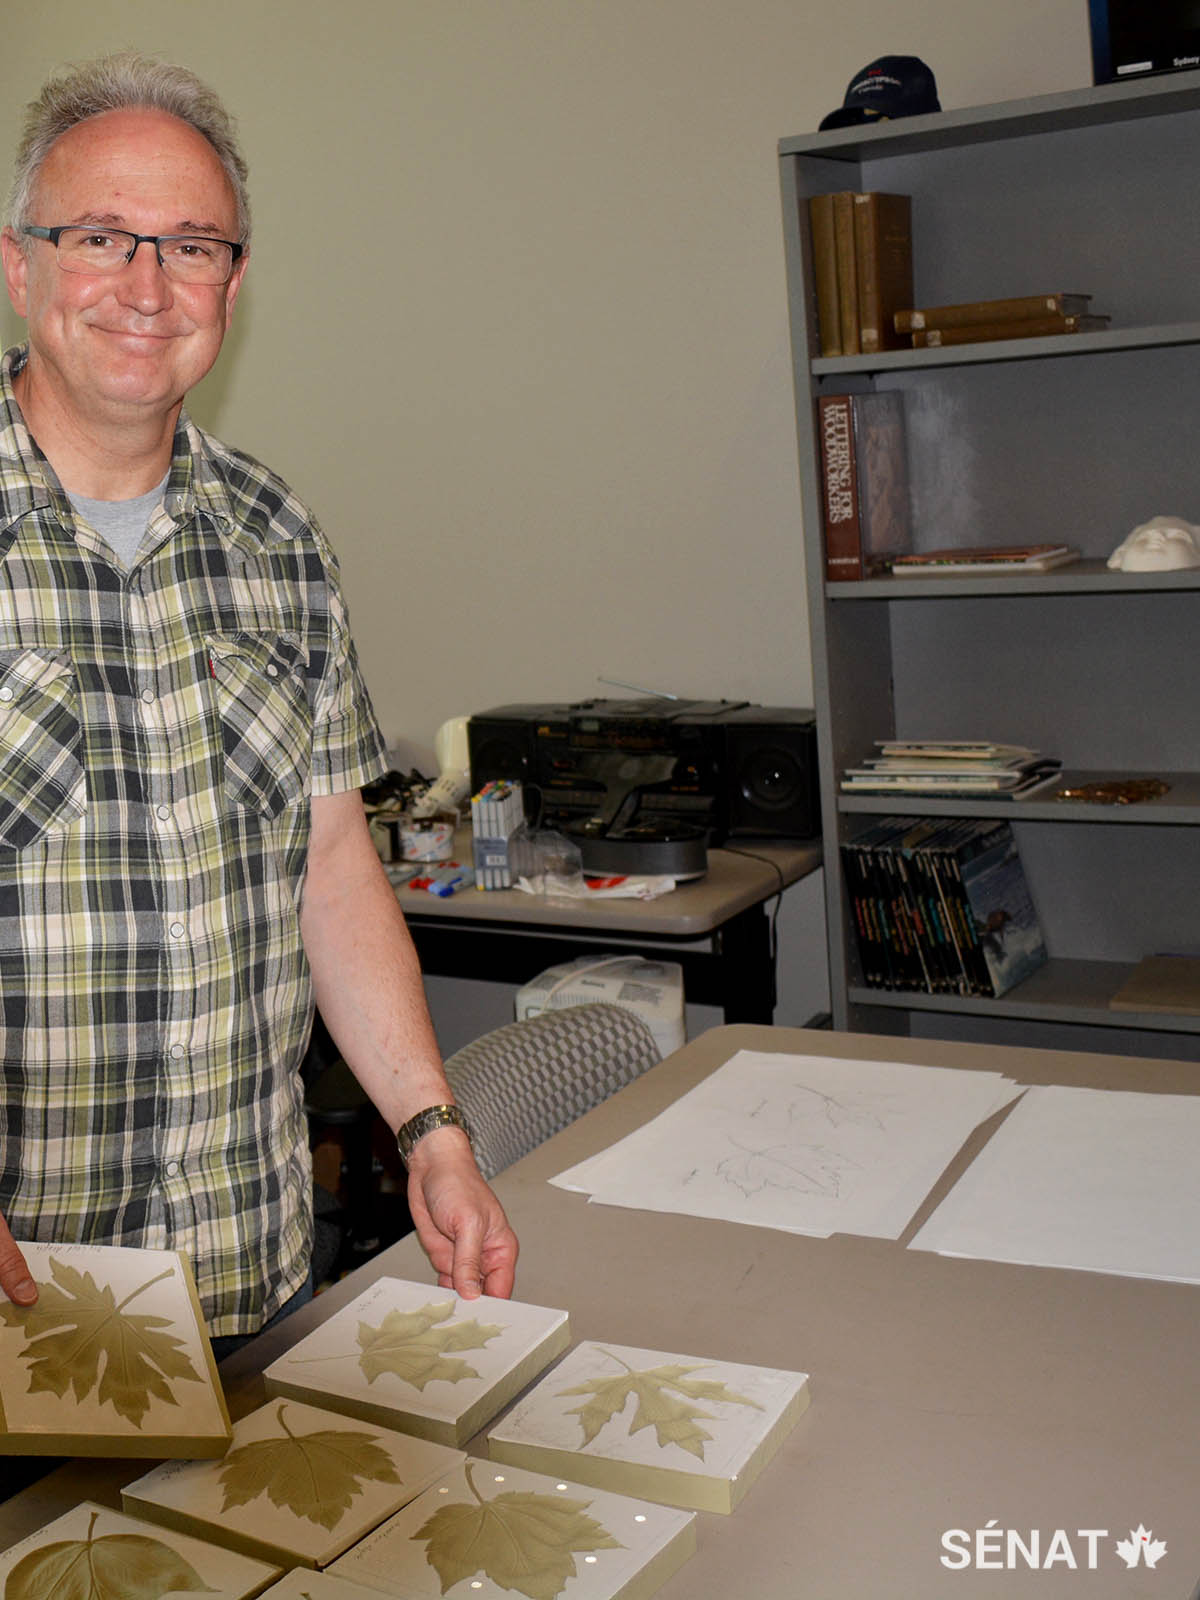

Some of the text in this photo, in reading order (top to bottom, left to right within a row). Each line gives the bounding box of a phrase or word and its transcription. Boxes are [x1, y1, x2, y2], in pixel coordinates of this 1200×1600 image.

[824, 405, 842, 523] WOODWORKERS
[834, 404, 853, 520] LETTERING FOR
